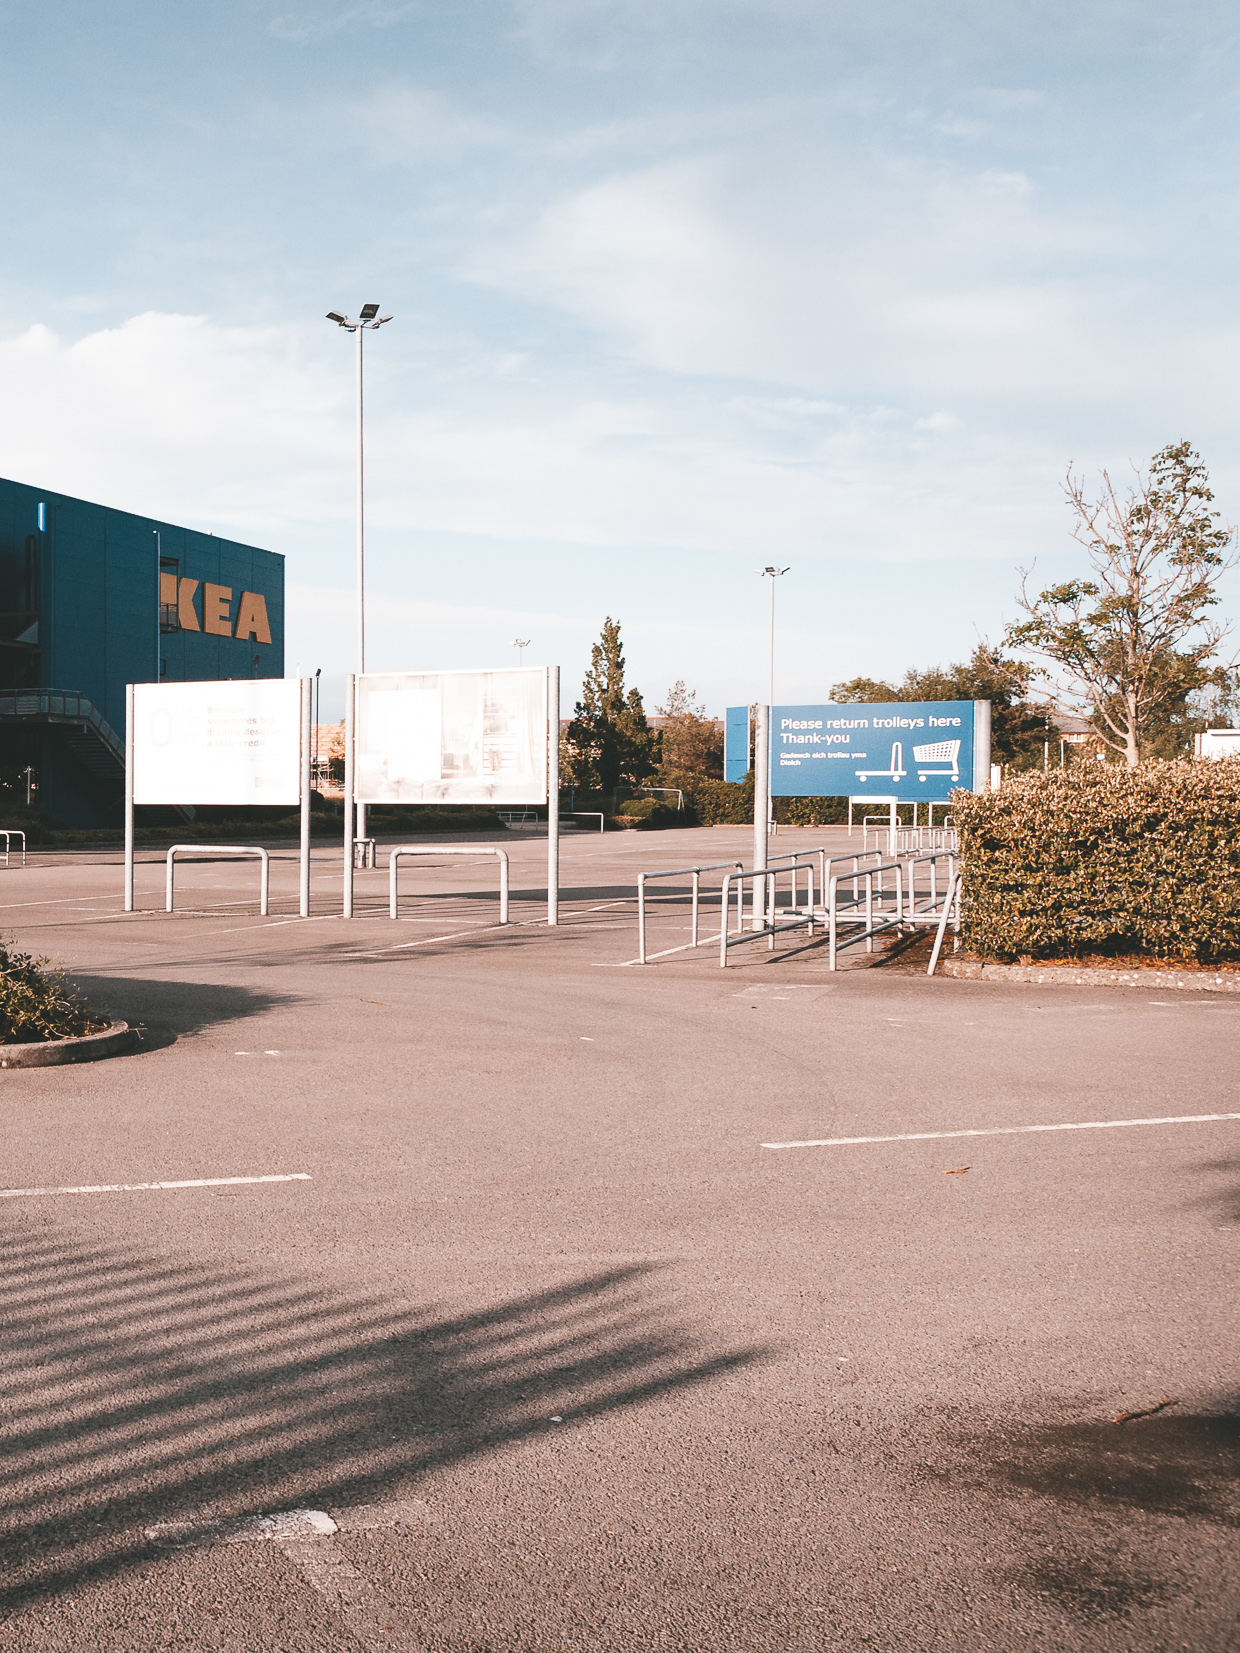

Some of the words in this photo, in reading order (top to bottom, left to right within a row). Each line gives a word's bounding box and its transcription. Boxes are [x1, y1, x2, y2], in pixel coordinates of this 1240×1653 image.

[160, 572, 272, 644] KEA
[207, 706, 245, 714] Because
[207, 717, 257, 725] sometimes
[260, 716, 275, 726] big
[781, 718, 823, 730] Please
[827, 719, 869, 729] return
[872, 717, 925, 730] trolleys
[928, 716, 962, 727] here
[207, 728, 240, 736] dreams
[244, 728, 281, 736] deserve
[239, 738, 266, 747] credit
[780, 733, 850, 746] Thank-you
